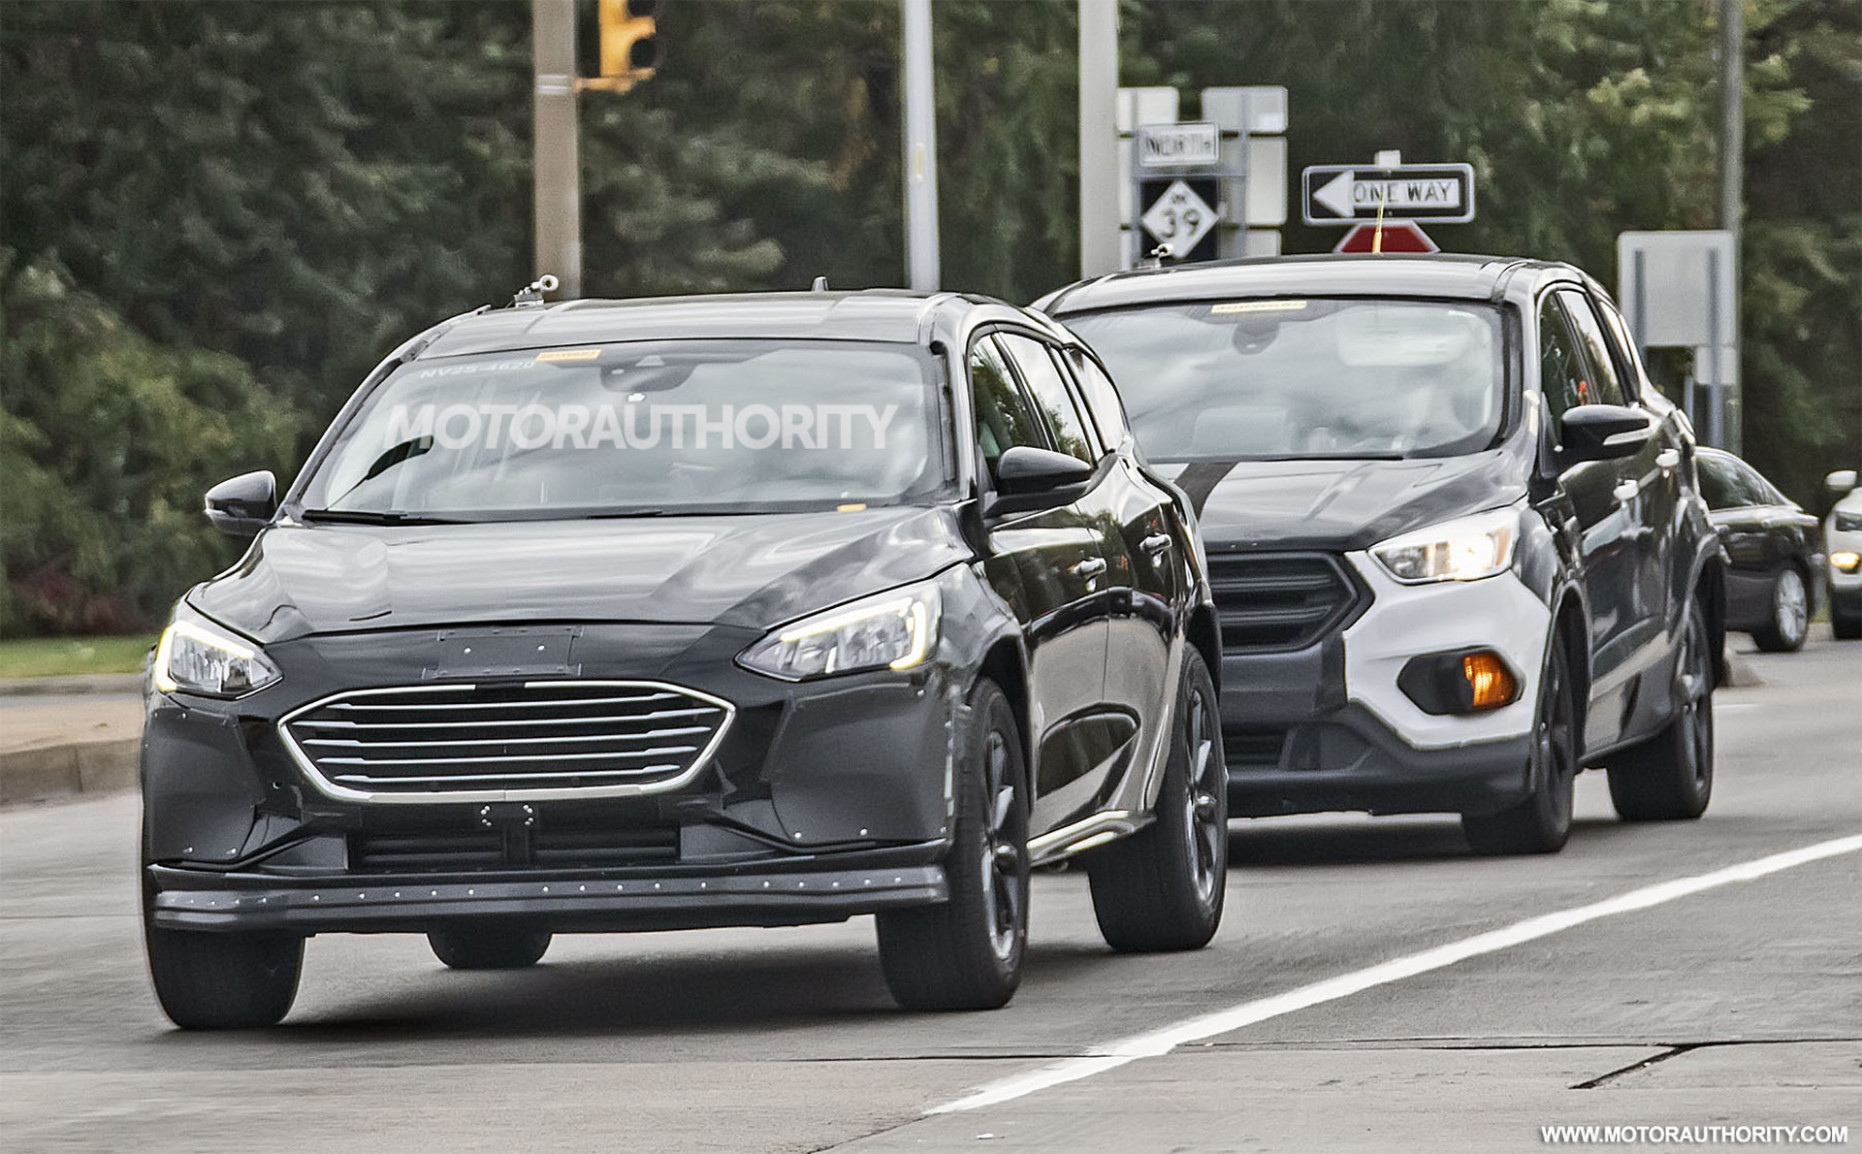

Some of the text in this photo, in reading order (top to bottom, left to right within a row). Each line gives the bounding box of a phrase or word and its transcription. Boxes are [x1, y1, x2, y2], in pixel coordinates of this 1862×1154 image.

[1146, 134, 1212, 156] NORTH
[1354, 181, 1453, 202] ONE WAY
[1160, 208, 1201, 238] 39
